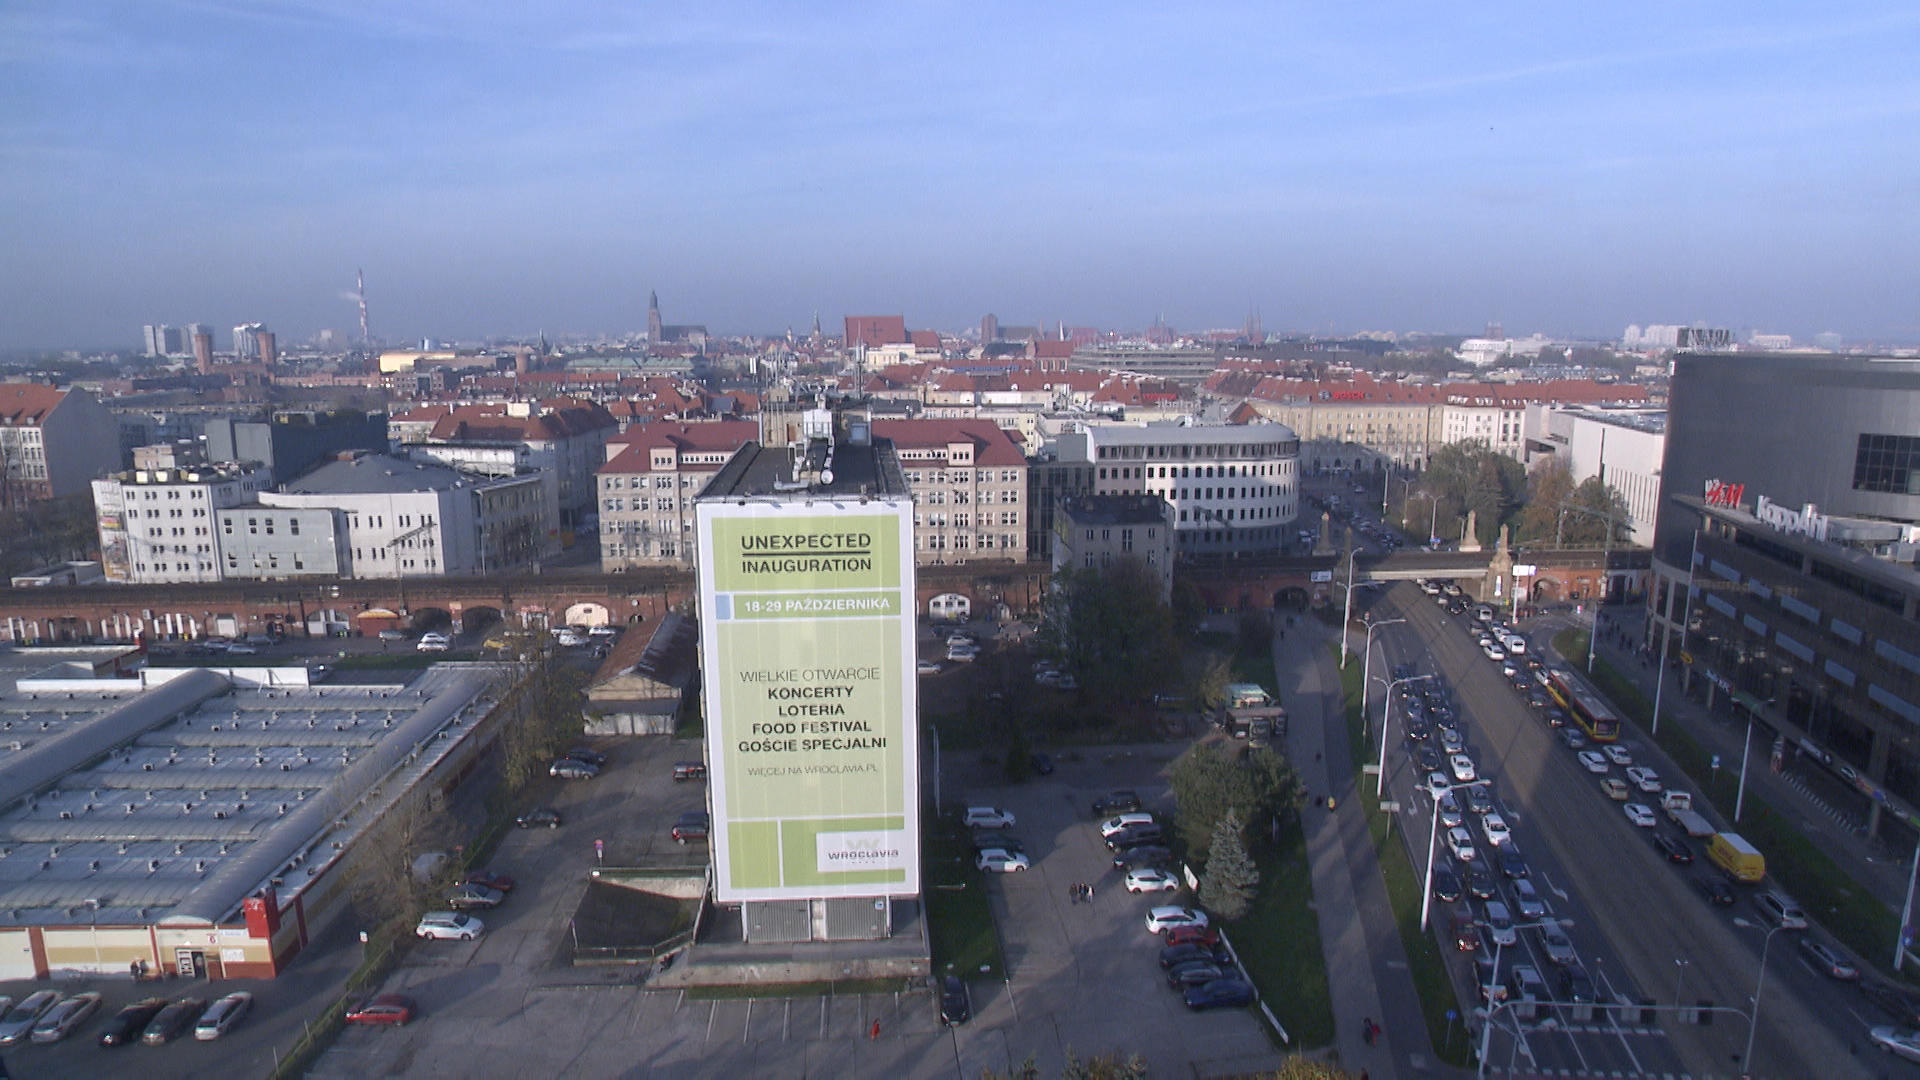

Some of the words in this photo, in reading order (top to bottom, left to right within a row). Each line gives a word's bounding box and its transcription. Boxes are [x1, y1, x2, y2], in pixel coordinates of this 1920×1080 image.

[741, 533, 871, 549] UNEXPECTED
[742, 558, 871, 573] INAUGURATION
[745, 601, 782, 612] 18-29
[785, 597, 890, 612] PAŹDZIERNIKA
[740, 670, 798, 682] WIELKIE
[802, 667, 880, 681] OTWARCIE
[768, 686, 853, 700] KONCERTY
[779, 704, 845, 716] LOTERIA
[752, 722, 796, 735] FOOD
[801, 720, 872, 733] FESTIVAL
[738, 738, 797, 752] GOŚCIE
[801, 737, 887, 750] SPECJALNI
[788, 766, 802, 775] NA
